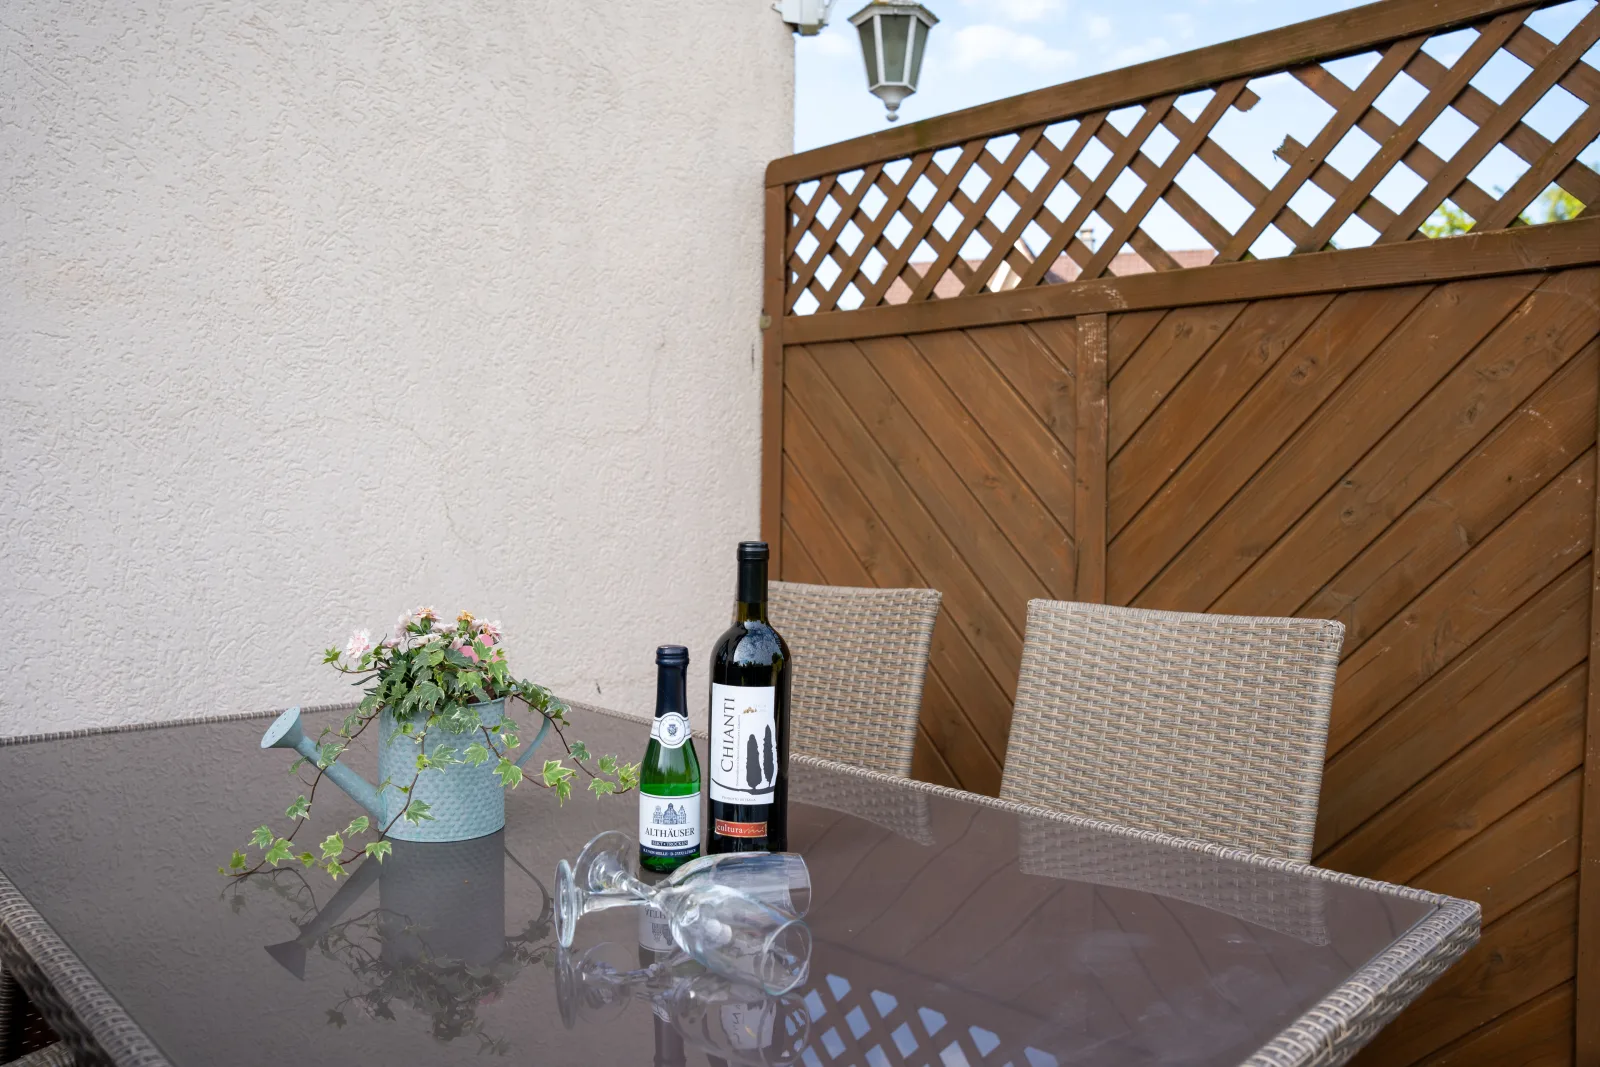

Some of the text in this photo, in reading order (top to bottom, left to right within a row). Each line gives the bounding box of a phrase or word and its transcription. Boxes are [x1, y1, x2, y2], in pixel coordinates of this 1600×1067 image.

[720, 697, 735, 773] CHIANTI
[645, 827, 695, 838] ALTHÄUSER
[716, 824, 743, 834] cultura
